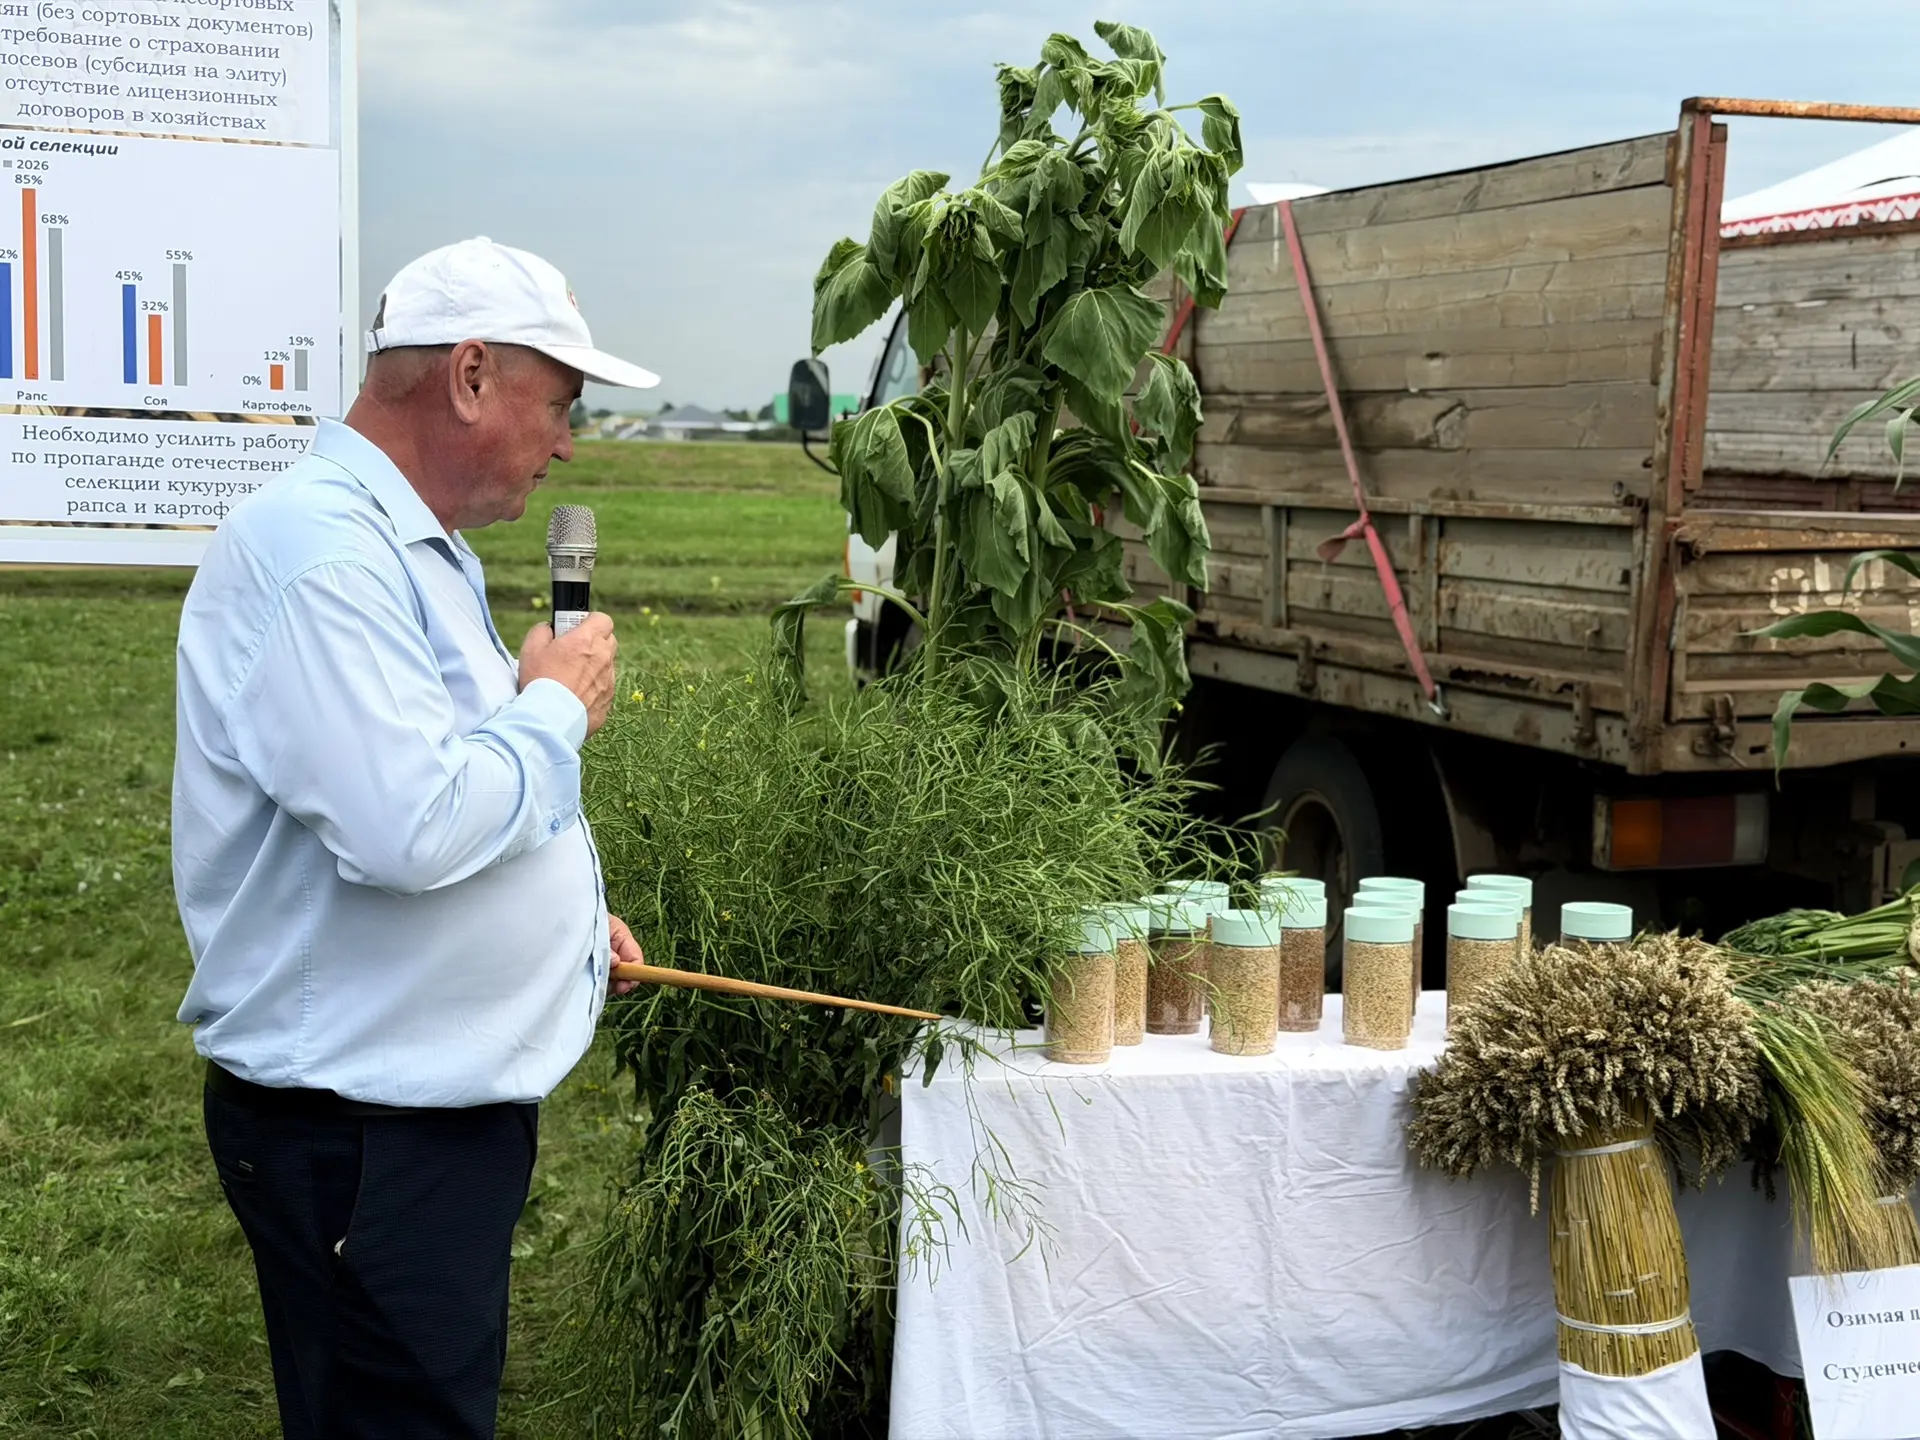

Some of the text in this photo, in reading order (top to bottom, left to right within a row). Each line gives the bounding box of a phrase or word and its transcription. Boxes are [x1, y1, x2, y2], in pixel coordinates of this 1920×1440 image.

[37, 1, 75, 23] (без
[81, 9, 181, 28] сортовых
[186, 17, 313, 42] документов)
[0, 26, 280, 59] требование о страховании
[85, 53, 187, 77] (субсидия
[194, 66, 220, 79] на
[225, 67, 287, 88] элиту)
[5, 78, 278, 107] отсутствие лицензионных
[16, 103, 267, 130] договоров в хозяйствах
[0, 135, 119, 157] ой селекции
[16, 159, 50, 171] 2026
[14, 173, 43, 186] 85%
[41, 213, 70, 225] 68%
[165, 249, 194, 261] 55%
[114, 270, 143, 282] 45%
[141, 300, 169, 312] 32%
[288, 335, 315, 347] 19%
[264, 350, 291, 362] 12%
[242, 375, 262, 386] 0%
[16, 390, 48, 402] Рапс
[143, 395, 168, 406] Соя
[242, 399, 312, 413] Картофель
[22, 424, 310, 454] Необходимо усилить работу
[11, 451, 37, 464] по
[43, 453, 165, 470] пропаганде
[65, 477, 160, 493] селекции
[66, 500, 235, 520] рапса и картоф
[1826, 1310, 1905, 1328] Озимая
